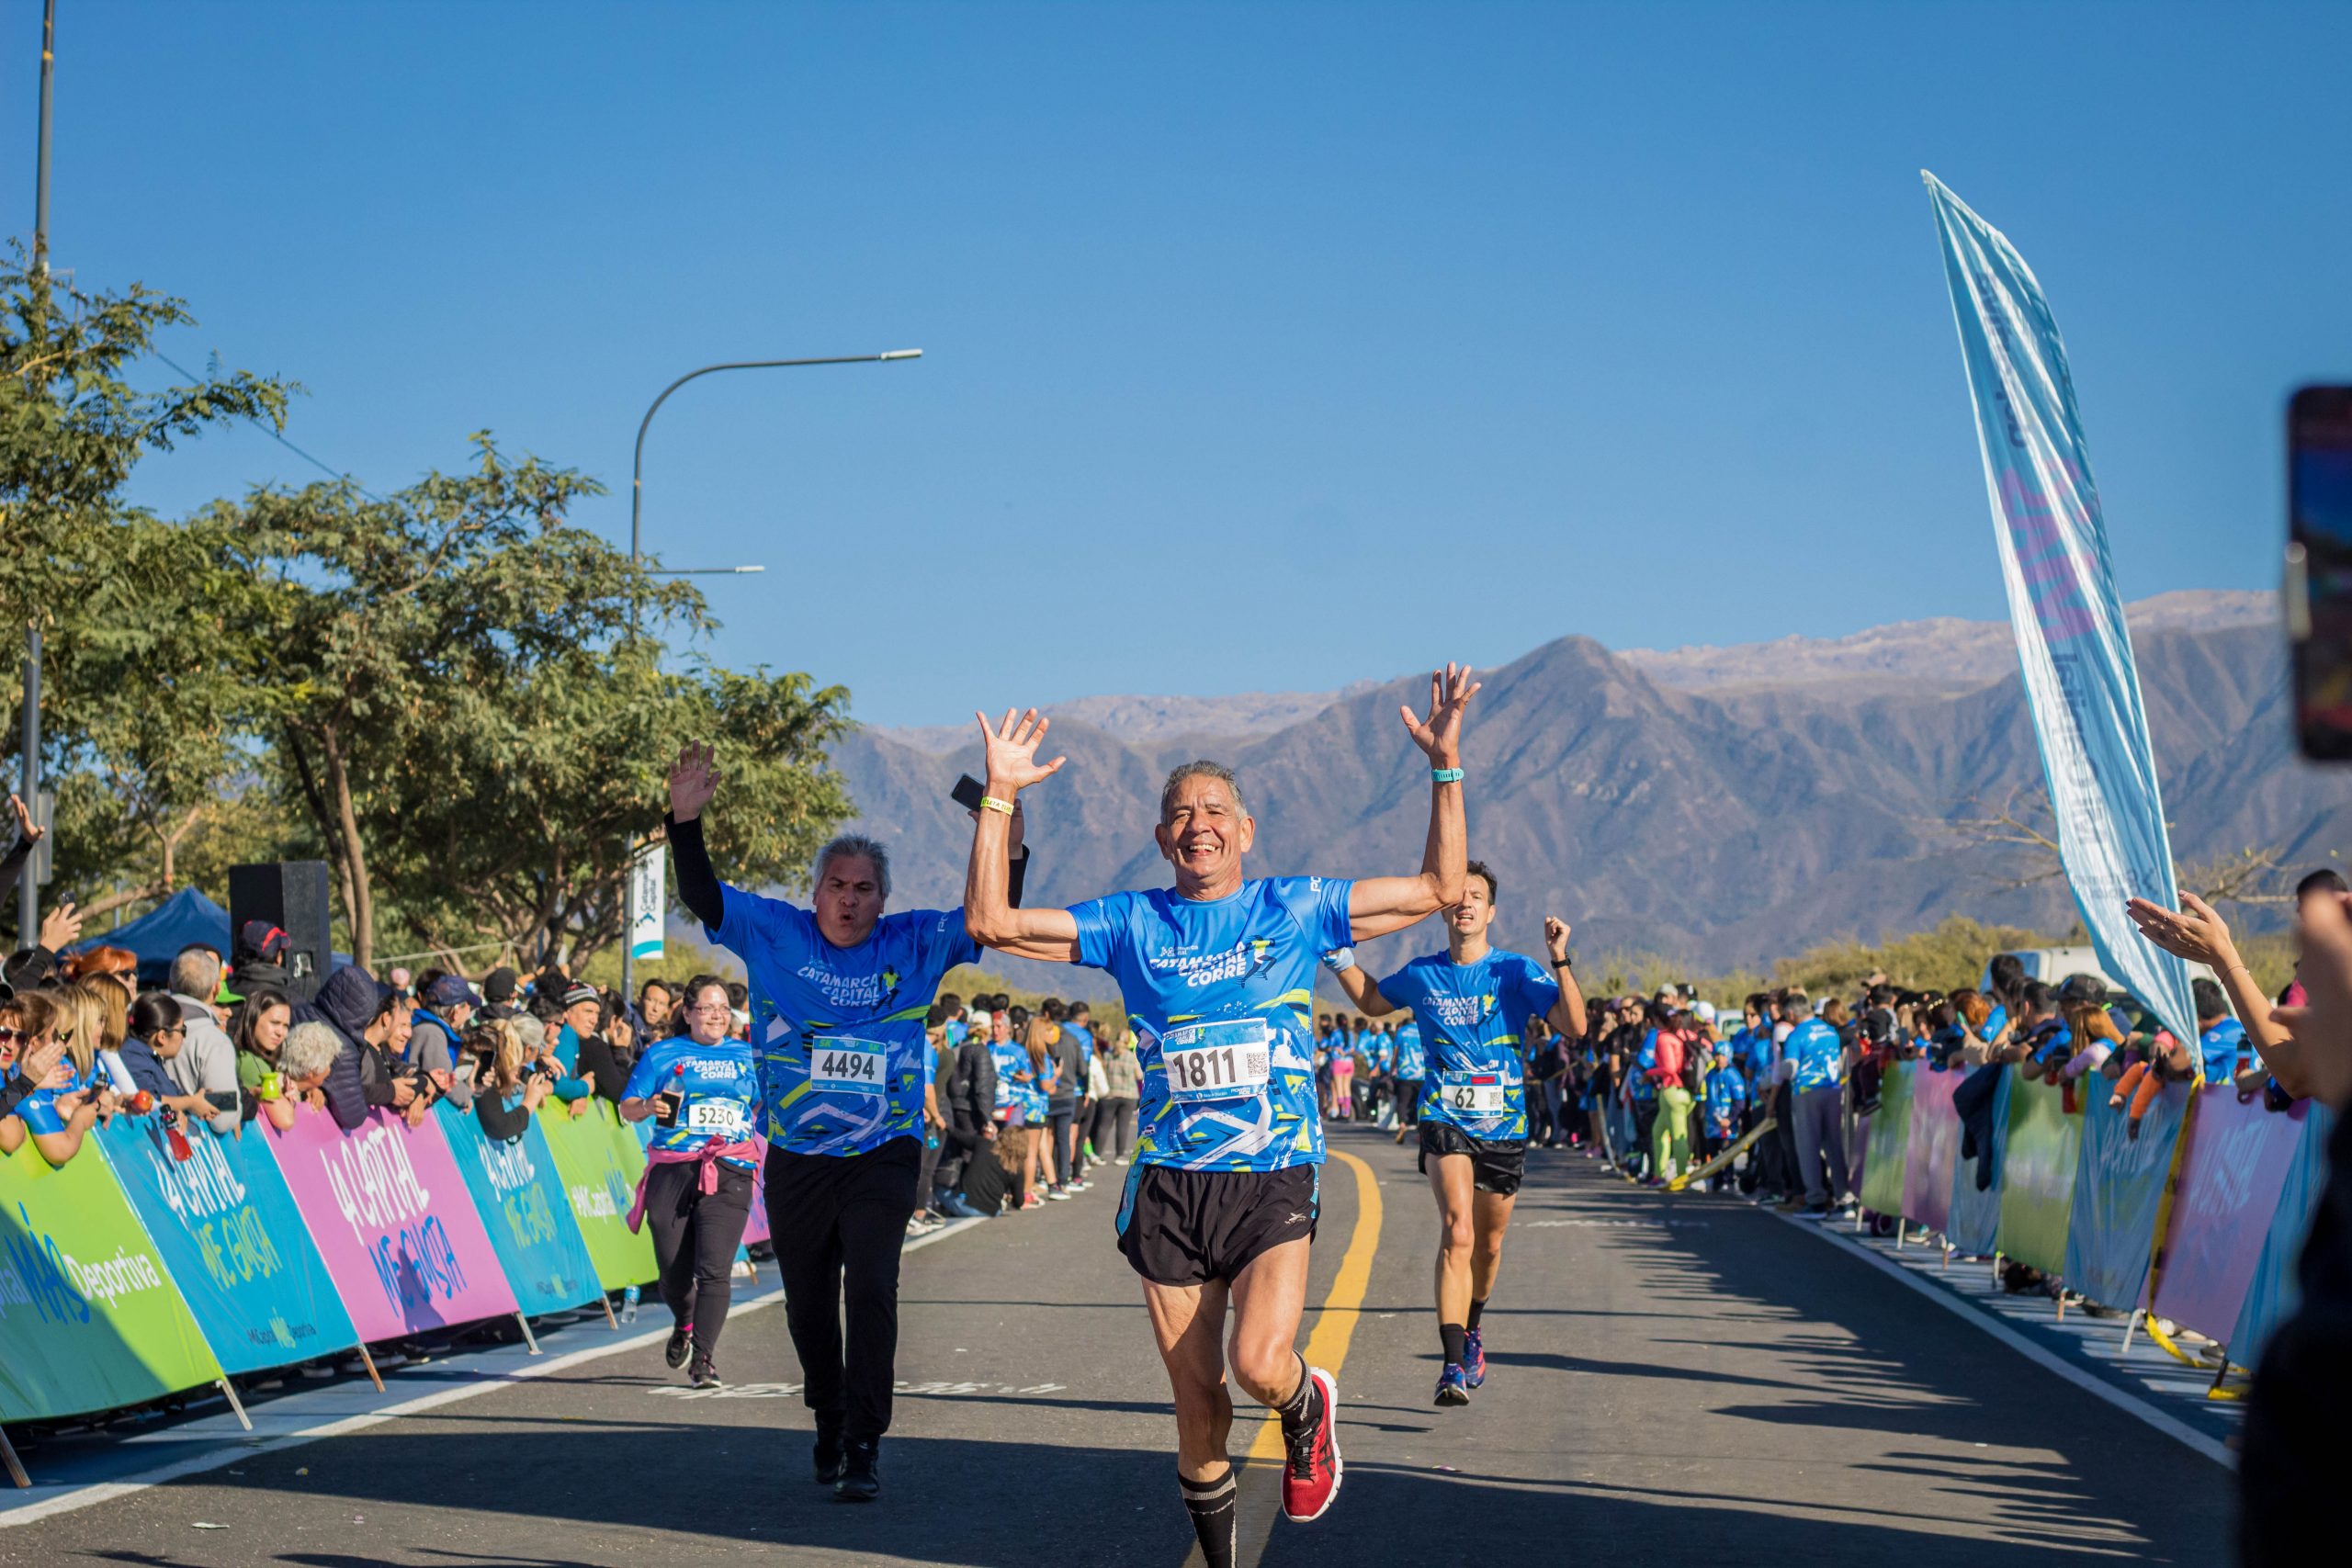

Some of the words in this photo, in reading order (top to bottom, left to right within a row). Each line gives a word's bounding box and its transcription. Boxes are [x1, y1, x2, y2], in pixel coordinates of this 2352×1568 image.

[797, 966, 879, 989] CATAMARCA
[1187, 962, 1247, 987] CORRE
[821, 985, 880, 1000] CAPITAL
[1422, 996, 1478, 1008] CATAMARCA
[1443, 1014, 1479, 1026] CORRE
[676, 1059, 735, 1069] TAMARCA
[700, 1070, 738, 1079] CORRE
[821, 1052, 875, 1080] 4494
[1173, 1048, 1236, 1089] 1811
[1455, 1088, 1476, 1109] 62
[698, 1107, 734, 1126] 5230
[340, 1123, 430, 1229] CAPITAL
[222, 1205, 283, 1283] GUSTA
[62, 1245, 162, 1309] Deportiva
[368, 1235, 414, 1318] ME
[400, 1215, 468, 1308] GUSTA
